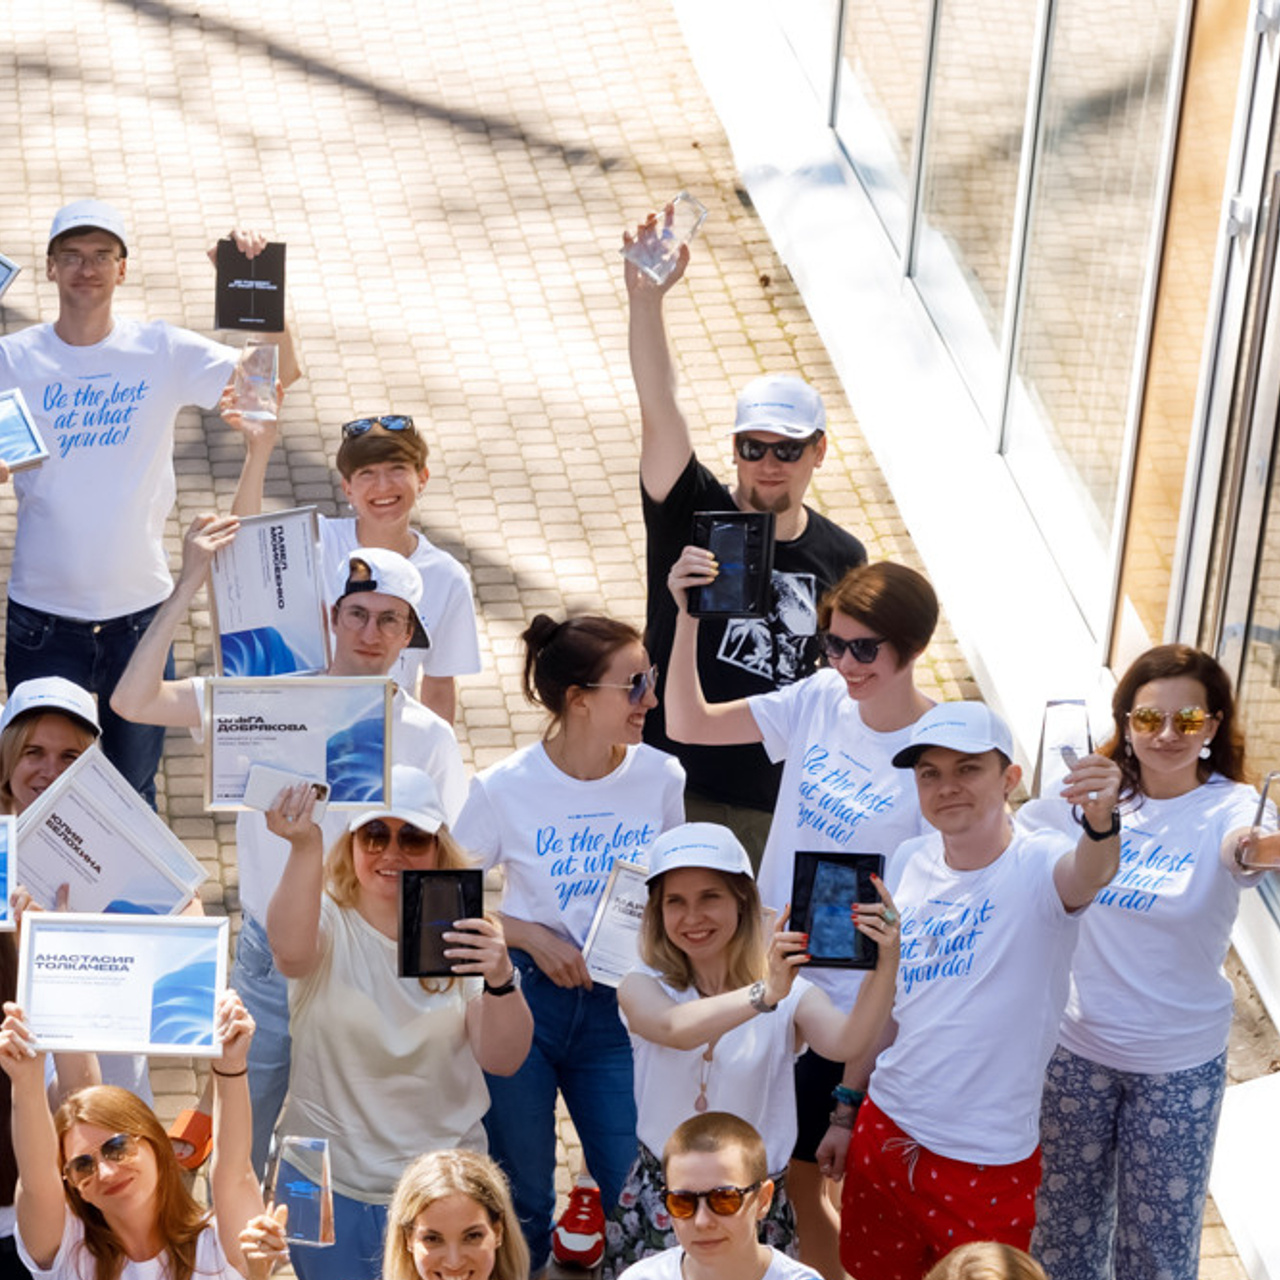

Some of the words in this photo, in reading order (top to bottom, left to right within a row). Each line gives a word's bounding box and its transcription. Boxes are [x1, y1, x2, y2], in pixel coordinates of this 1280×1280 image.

[53, 409, 79, 429] at
[217, 724, 308, 733] ДОБРЯКОВА
[569, 826, 606, 852] the
[612, 822, 654, 848] best
[550, 855, 578, 877] at
[35, 953, 135, 963] АНАСТАСИЯ
[34, 961, 130, 972] ТОЛКАЧЕВА
